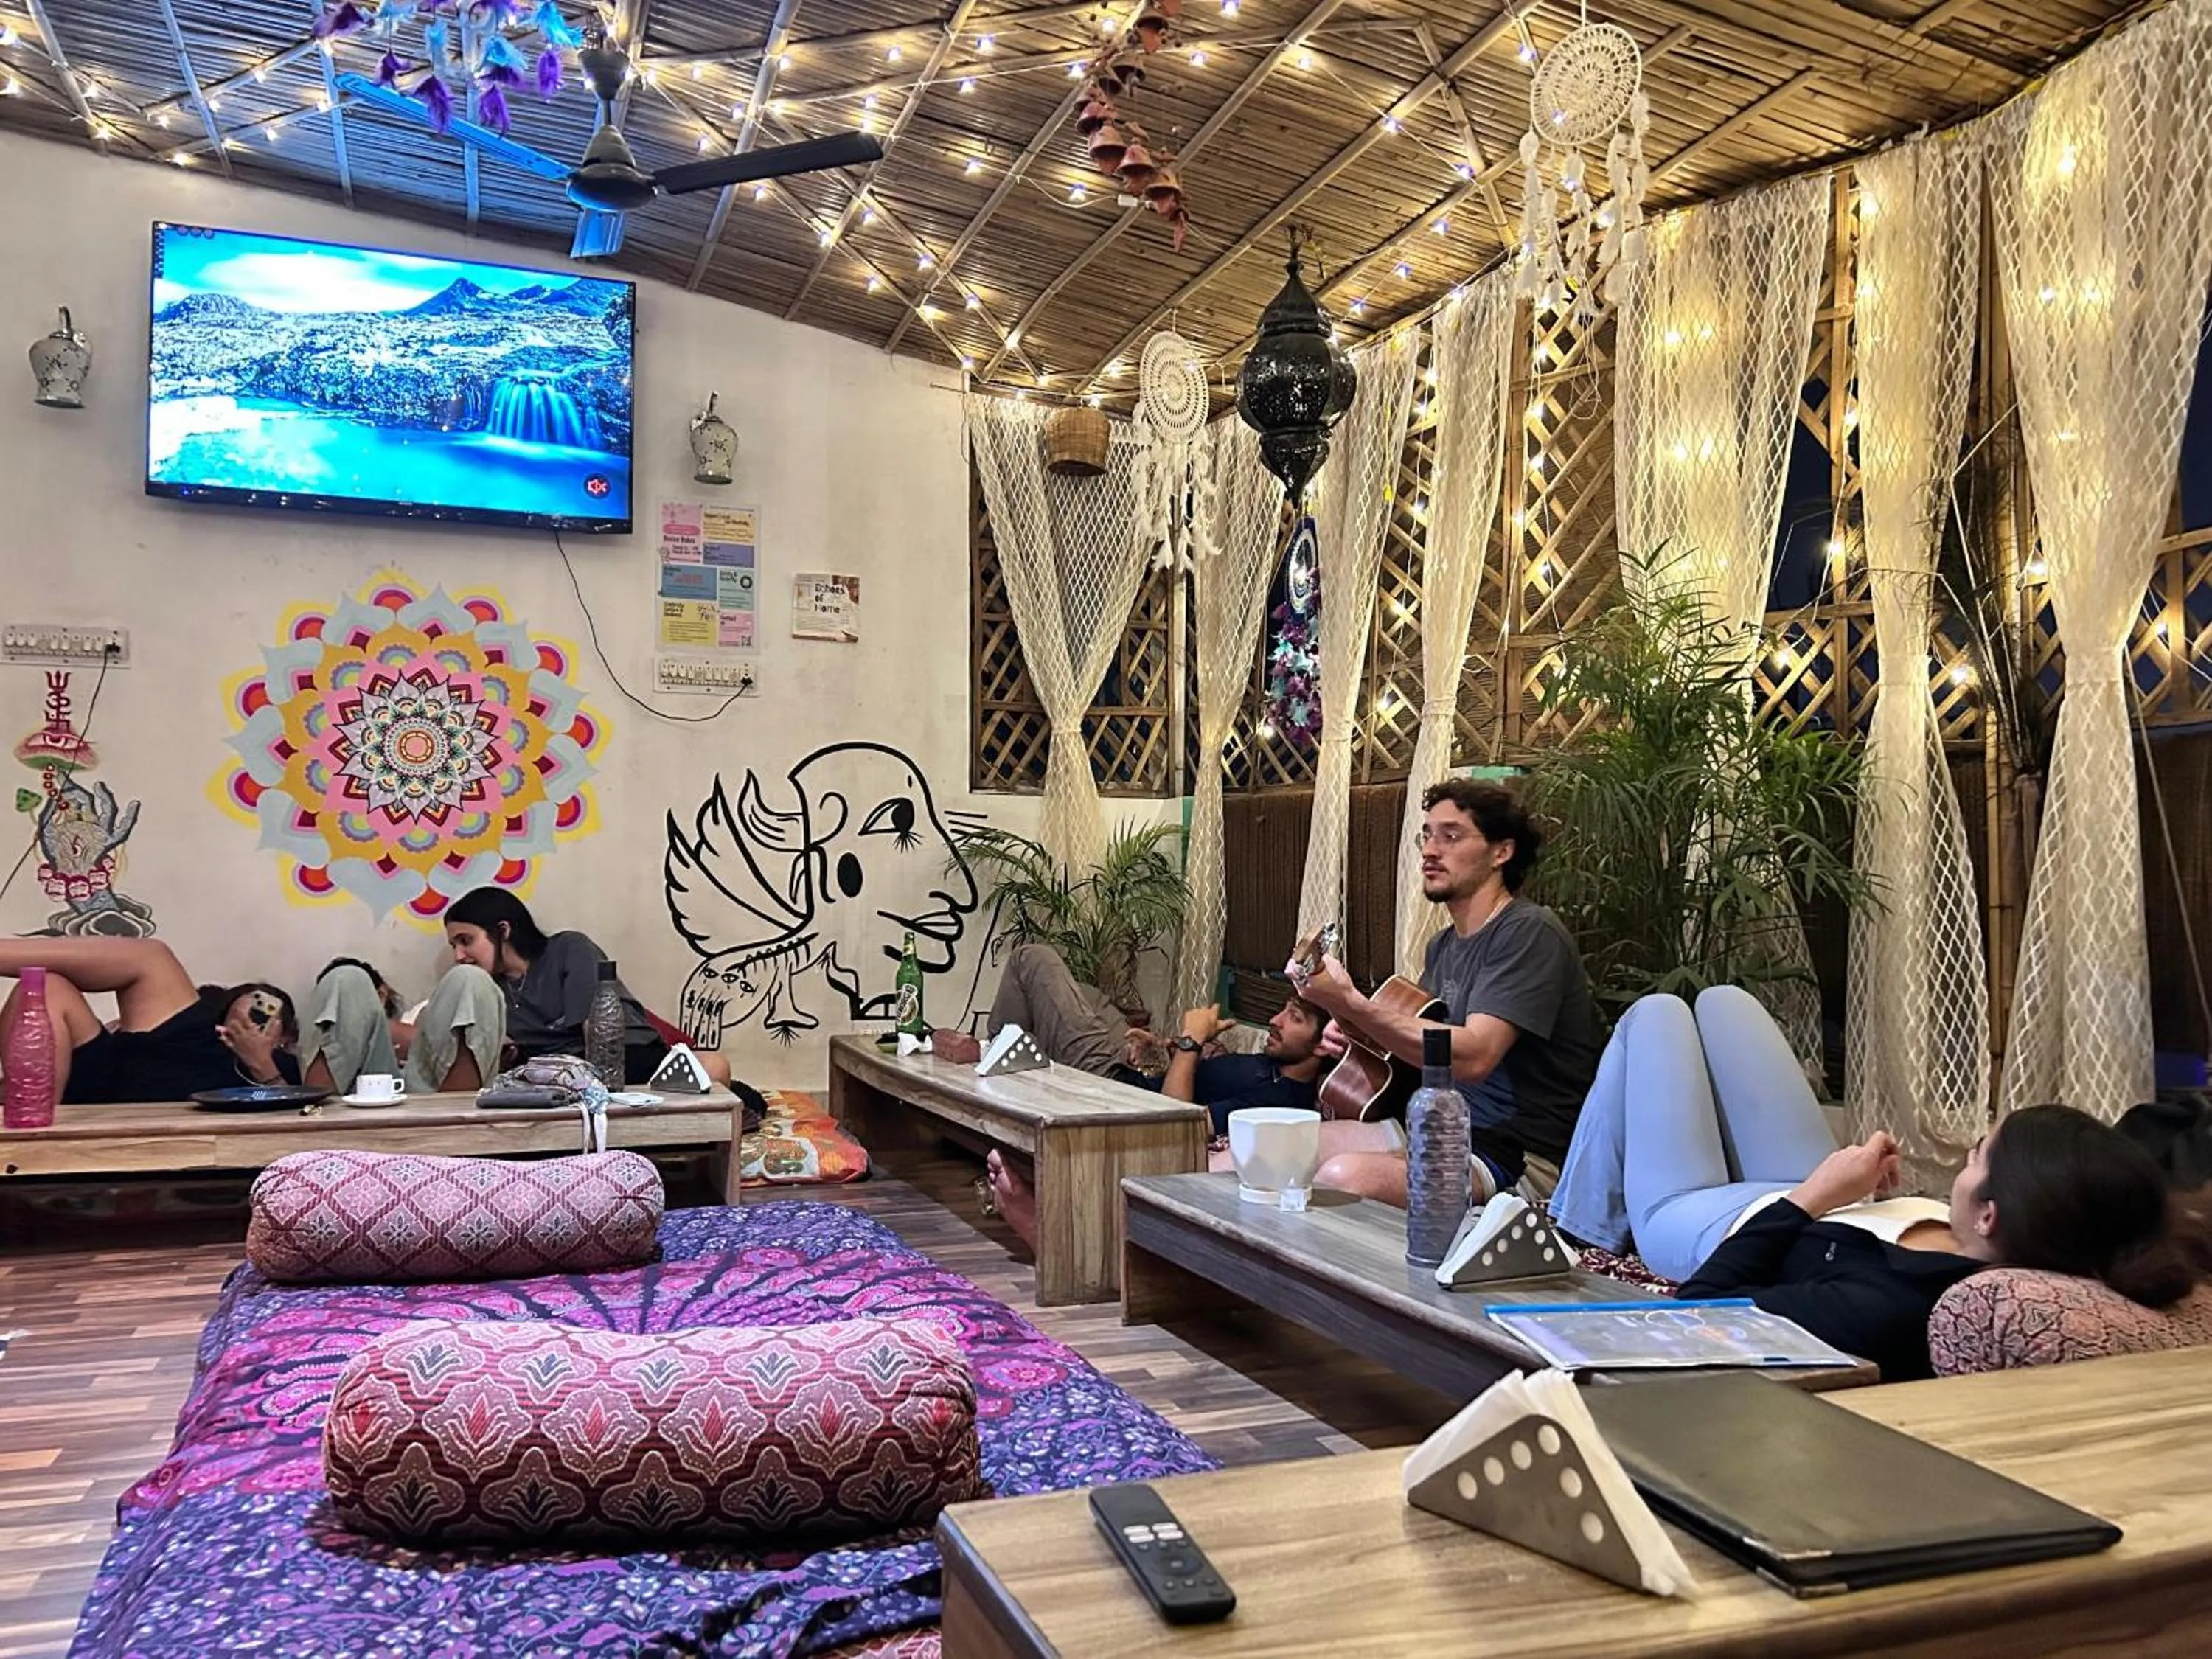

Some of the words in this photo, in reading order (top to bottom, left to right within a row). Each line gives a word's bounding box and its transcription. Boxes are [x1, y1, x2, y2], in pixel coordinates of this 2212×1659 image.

[815, 583, 844, 594] Echoes
[815, 594, 824, 602] of
[815, 603, 840, 613] Home
